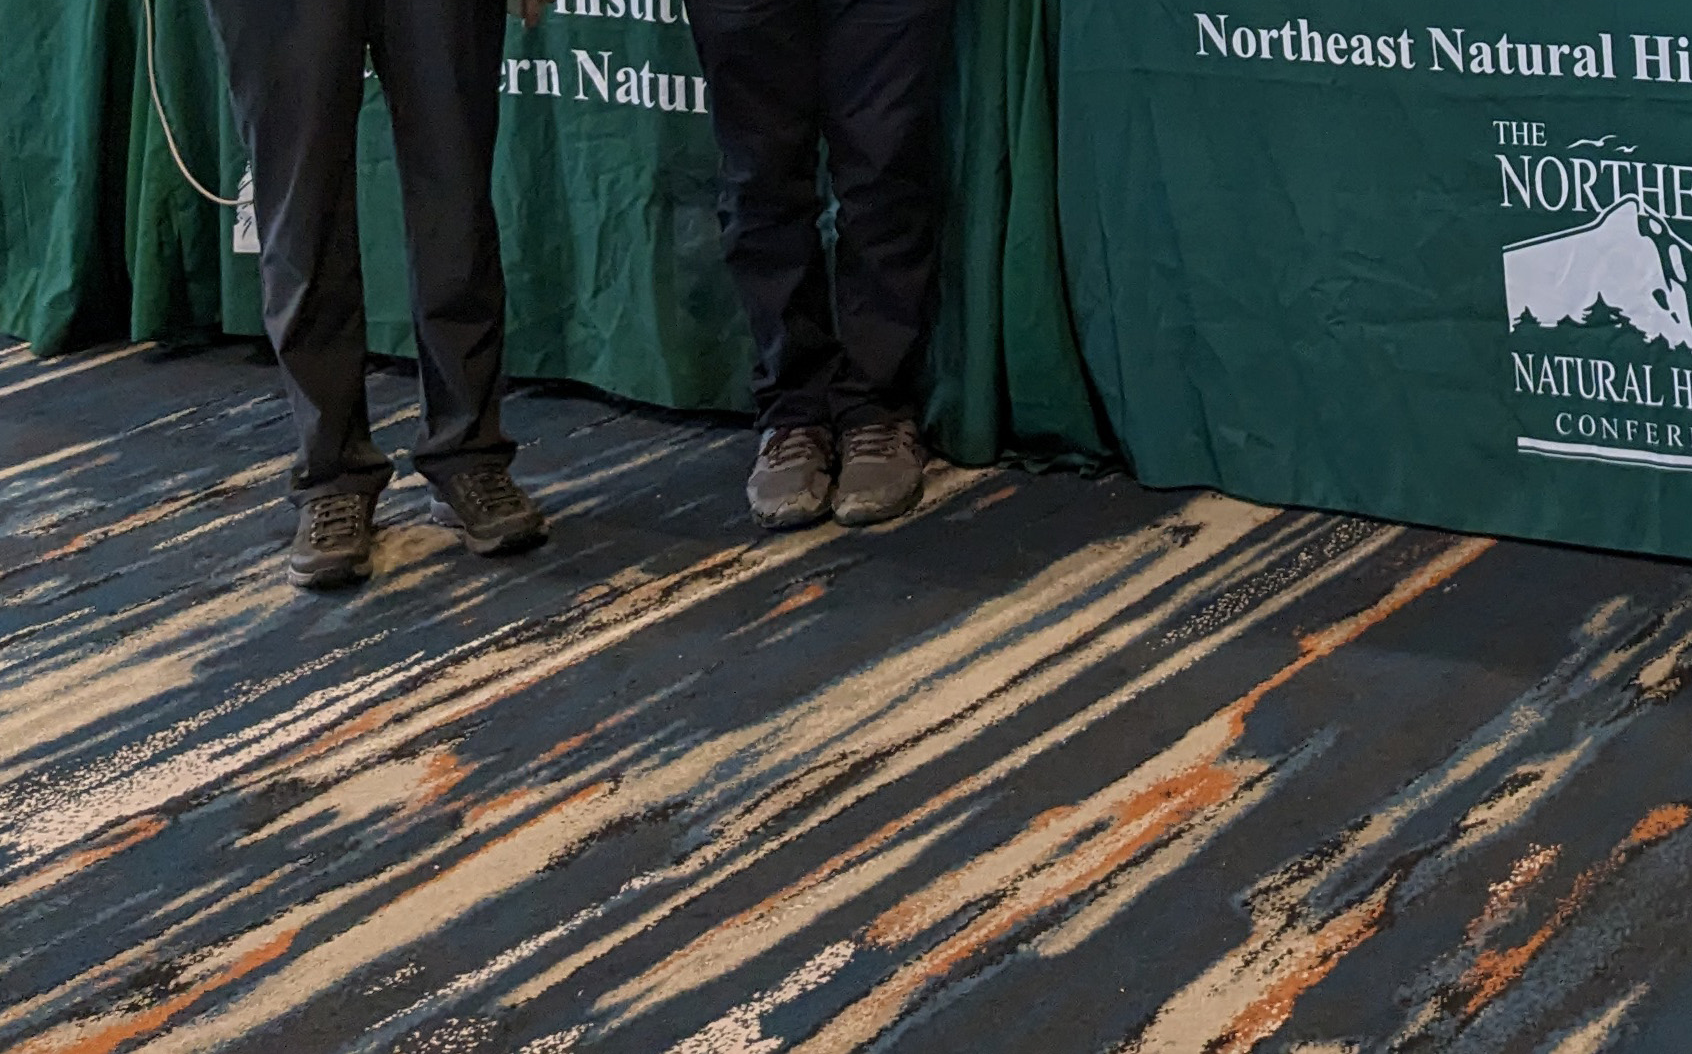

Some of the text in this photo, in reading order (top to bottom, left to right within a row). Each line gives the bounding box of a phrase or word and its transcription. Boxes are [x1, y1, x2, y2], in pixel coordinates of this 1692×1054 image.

[1193, 12, 1416, 70] Northeast
[1426, 26, 1617, 79] Natural
[1492, 119, 1548, 147] THE
[1511, 351, 1665, 407] NATURAL
